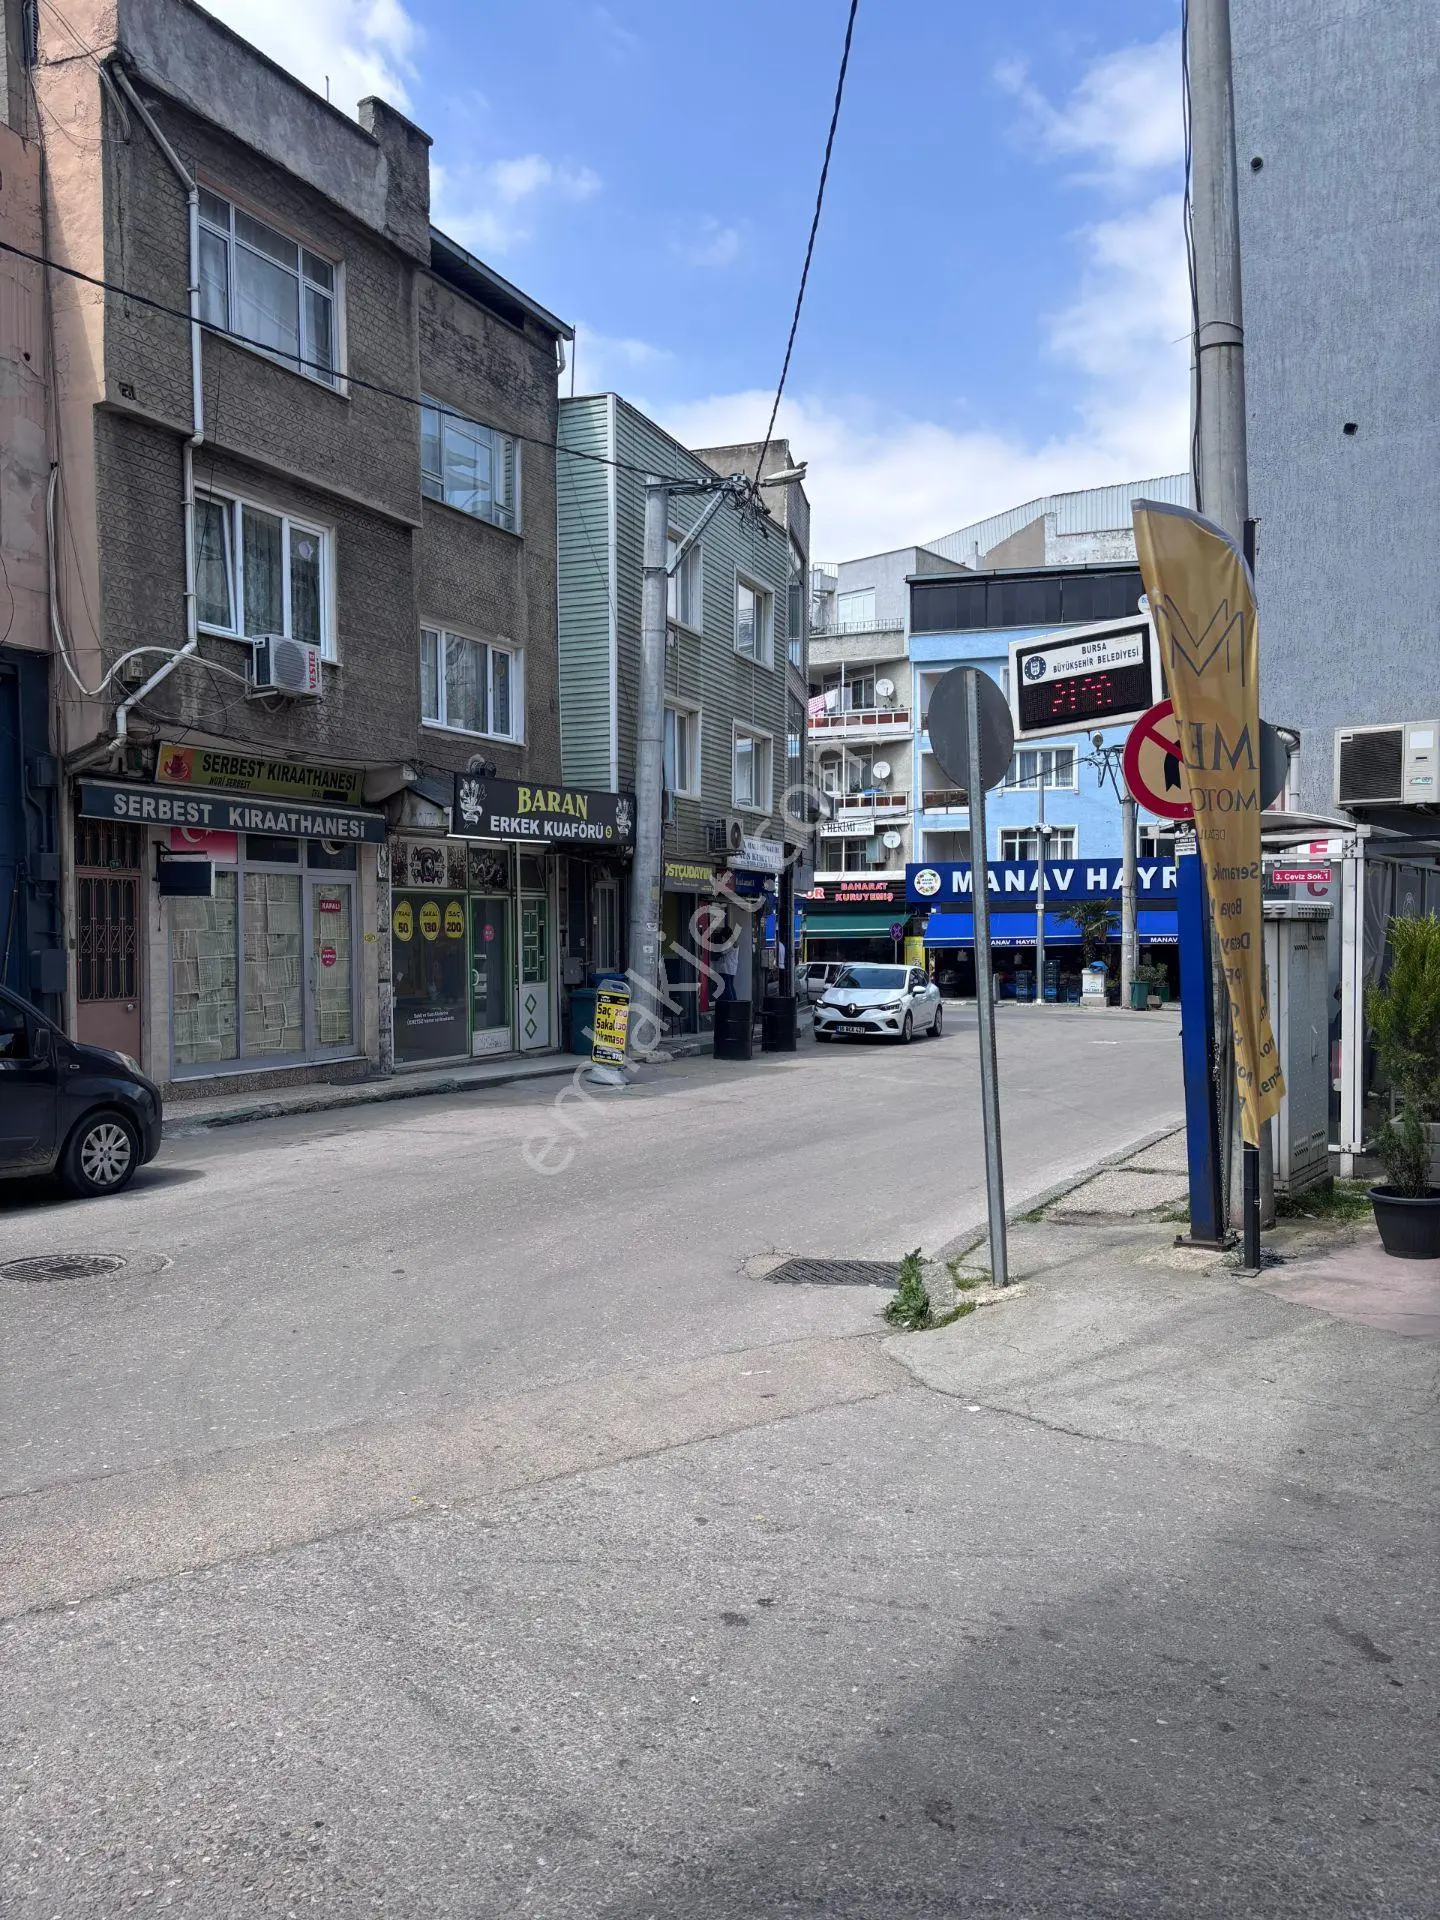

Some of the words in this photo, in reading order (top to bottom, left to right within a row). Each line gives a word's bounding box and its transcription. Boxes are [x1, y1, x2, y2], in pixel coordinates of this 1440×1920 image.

[1081, 642, 1107, 655] BURSA
[1053, 658, 1094, 674] BÜYÜKŞEHİR
[1097, 646, 1139, 664] BELEDİYESİ
[202, 753, 265, 780] SERBEST
[113, 793, 213, 824] SERBEST
[517, 786, 588, 820] BARAN
[490, 815, 540, 835] ERKEK
[544, 817, 604, 839] KUAFÖRÜ
[952, 867, 1075, 893] MANAV
[1284, 872, 1305, 881] Ceviz
[398, 922, 409, 933] 50
[446, 921, 462, 933] 200
[1150, 936, 1178, 944] MANAV
[597, 1003, 612, 1018] Saç
